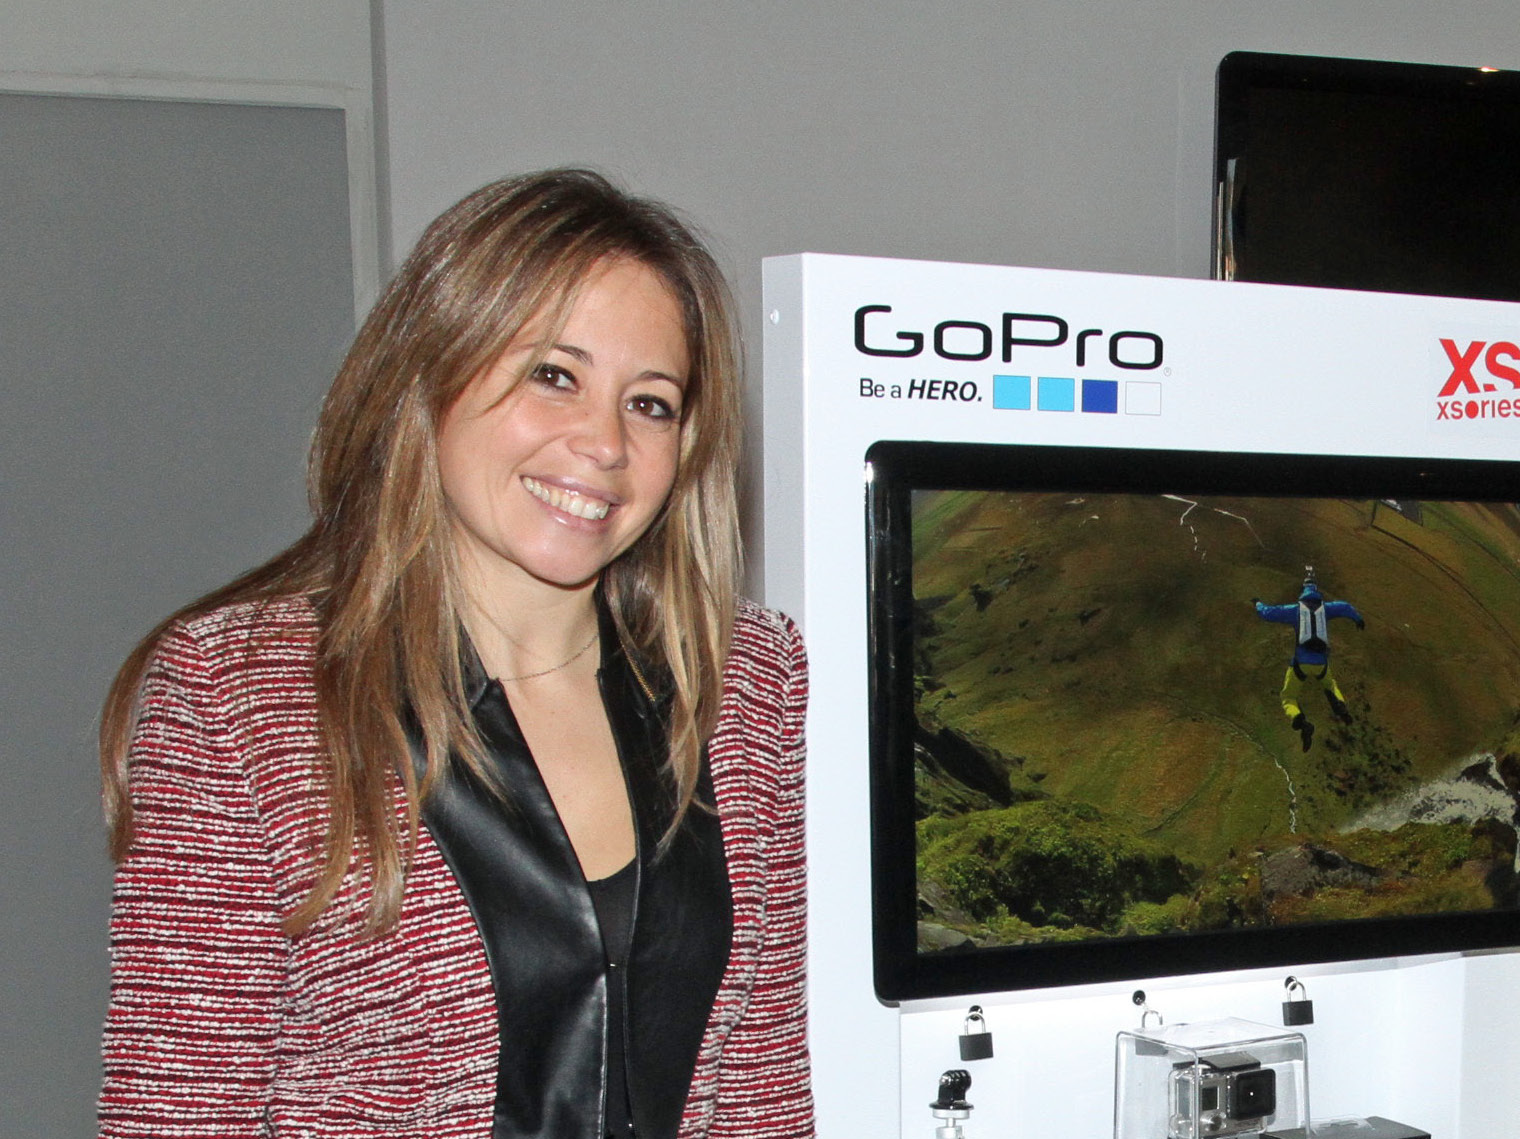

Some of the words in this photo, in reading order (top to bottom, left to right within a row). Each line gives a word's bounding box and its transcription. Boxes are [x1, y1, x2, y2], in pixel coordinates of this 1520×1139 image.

[854, 304, 1164, 370] GoPro
[859, 378, 885, 398] Be
[890, 384, 902, 399] a
[907, 379, 983, 402] HERO.
